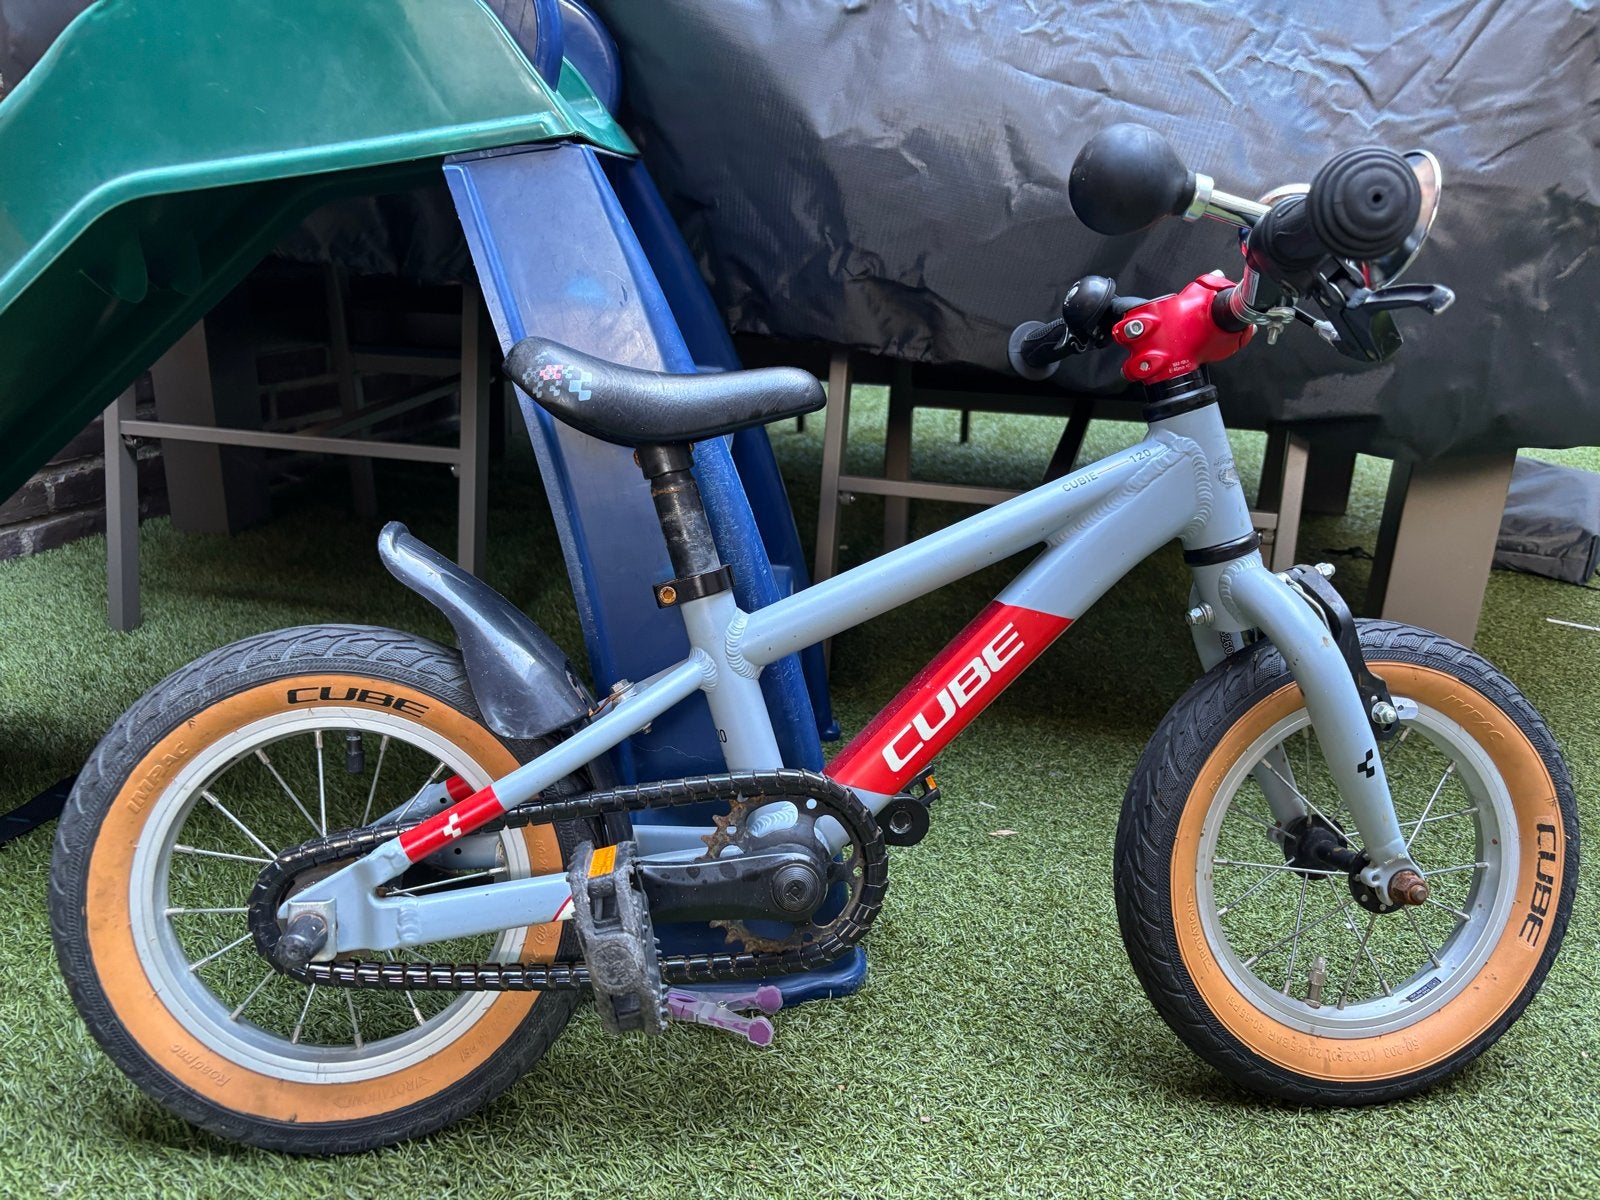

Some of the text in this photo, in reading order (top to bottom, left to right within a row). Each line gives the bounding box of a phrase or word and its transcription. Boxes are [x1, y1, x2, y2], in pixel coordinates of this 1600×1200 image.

[1062, 448, 1152, 492] CUBIE 120
[287, 686, 430, 719] CUBE
[882, 622, 1025, 773] CUBE
[127, 740, 189, 815] IMPAC
[1518, 823, 1556, 947] CUBE
